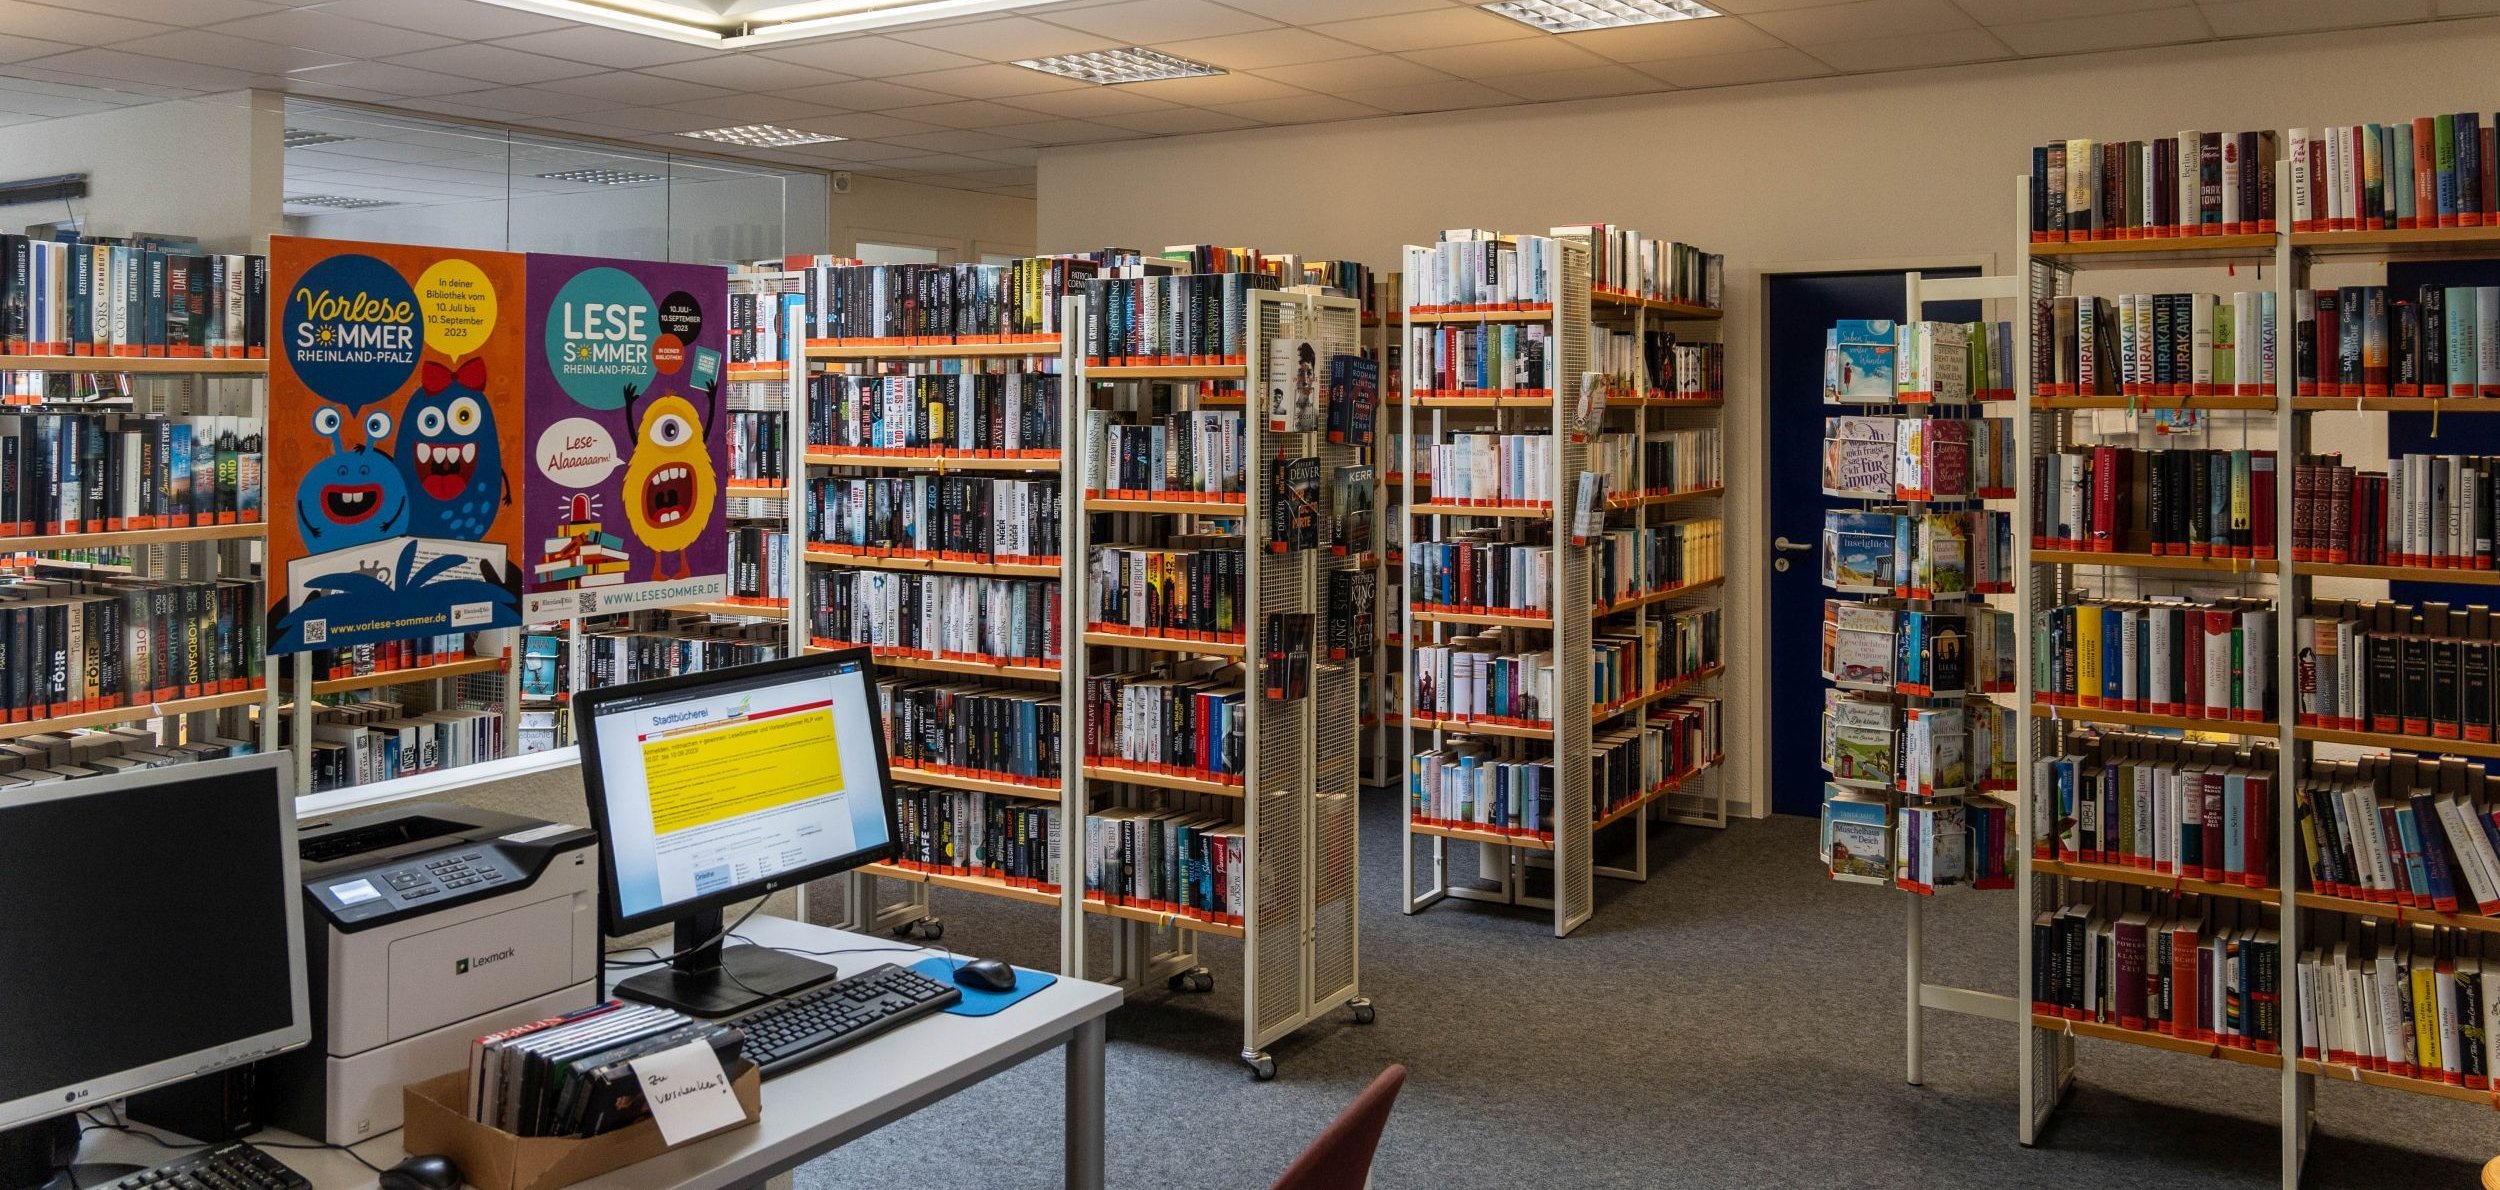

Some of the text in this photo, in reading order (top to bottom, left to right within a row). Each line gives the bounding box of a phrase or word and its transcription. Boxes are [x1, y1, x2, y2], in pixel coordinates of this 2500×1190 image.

[2182, 153, 2191, 178] Berlin
[2201, 185, 2221, 196] DARK
[2296, 166, 2305, 207] KILEY REID
[18, 250, 26, 286] CAMBRIDGE
[172, 268, 187, 290] DAHL
[426, 290, 485, 301] Bibliothek vom
[439, 278, 474, 288] In deiner
[297, 287, 414, 324] Vorlese
[449, 303, 463, 313] Juli
[464, 304, 476, 313] bis
[1112, 280, 1120, 341] FORDERUNG
[2343, 301, 2351, 323] Golden
[115, 307, 126, 338] CORS
[440, 315, 484, 327] September
[444, 328, 467, 337] 2023
[564, 302, 647, 341] LESE
[1176, 311, 1184, 354] JOHN GRISHAM
[1089, 314, 1098, 355] JOHN GRISHAM
[2079, 309, 2092, 384] MURAKAMI
[2121, 308, 2135, 384] MURAKAMI
[2139, 309, 2152, 384] MURAKAMI
[2156, 305, 2171, 384] MURAKAMI
[2176, 306, 2191, 384] MURAKAMI
[2263, 311, 2276, 381] MURAKAMI
[2351, 324, 2359, 361] RUSHDIE
[297, 349, 413, 365] RHEINLAND-PFALZ
[1353, 360, 1377, 371] HILLARY
[563, 364, 648, 376] RHEINLAND-PFALZ
[1352, 369, 1376, 381] RODHAM
[1352, 379, 1376, 390] CLINTON
[566, 435, 598, 450] Lese-
[219, 462, 227, 482] TOD
[228, 459, 237, 485] LAND
[241, 456, 250, 491] WINTER
[1290, 466, 1319, 480] DEAVER
[1350, 469, 1373, 482] KERR
[928, 485, 937, 509] ZERO
[2464, 476, 2472, 510] TERROR
[2449, 503, 2459, 537] GOTT
[1166, 561, 1173, 575] 42
[603, 583, 720, 606] WWW.LESESOMMER.DE
[1351, 583, 1375, 602] KING
[330, 612, 447, 635] www.vorlese-sommer.de
[1336, 619, 1347, 650] KING
[187, 617, 198, 684] MORDSAND
[628, 651, 637, 671] BLIND
[52, 650, 66, 693] FÖHR
[2066, 647, 2074, 691] EDNA O'BRIEN
[652, 708, 709, 727] Stadtbücherei
[904, 697, 912, 741] SOMMERNACHT
[1087, 703, 1095, 745] KONKLAVE
[925, 718, 935, 743] NEVER
[2083, 804, 2094, 829] 1984
[921, 831, 930, 863] SAFE
[1049, 817, 1061, 859] WHITE SLEEP
[472, 948, 515, 969] Lexmark
[77, 1089, 89, 1098] LG
